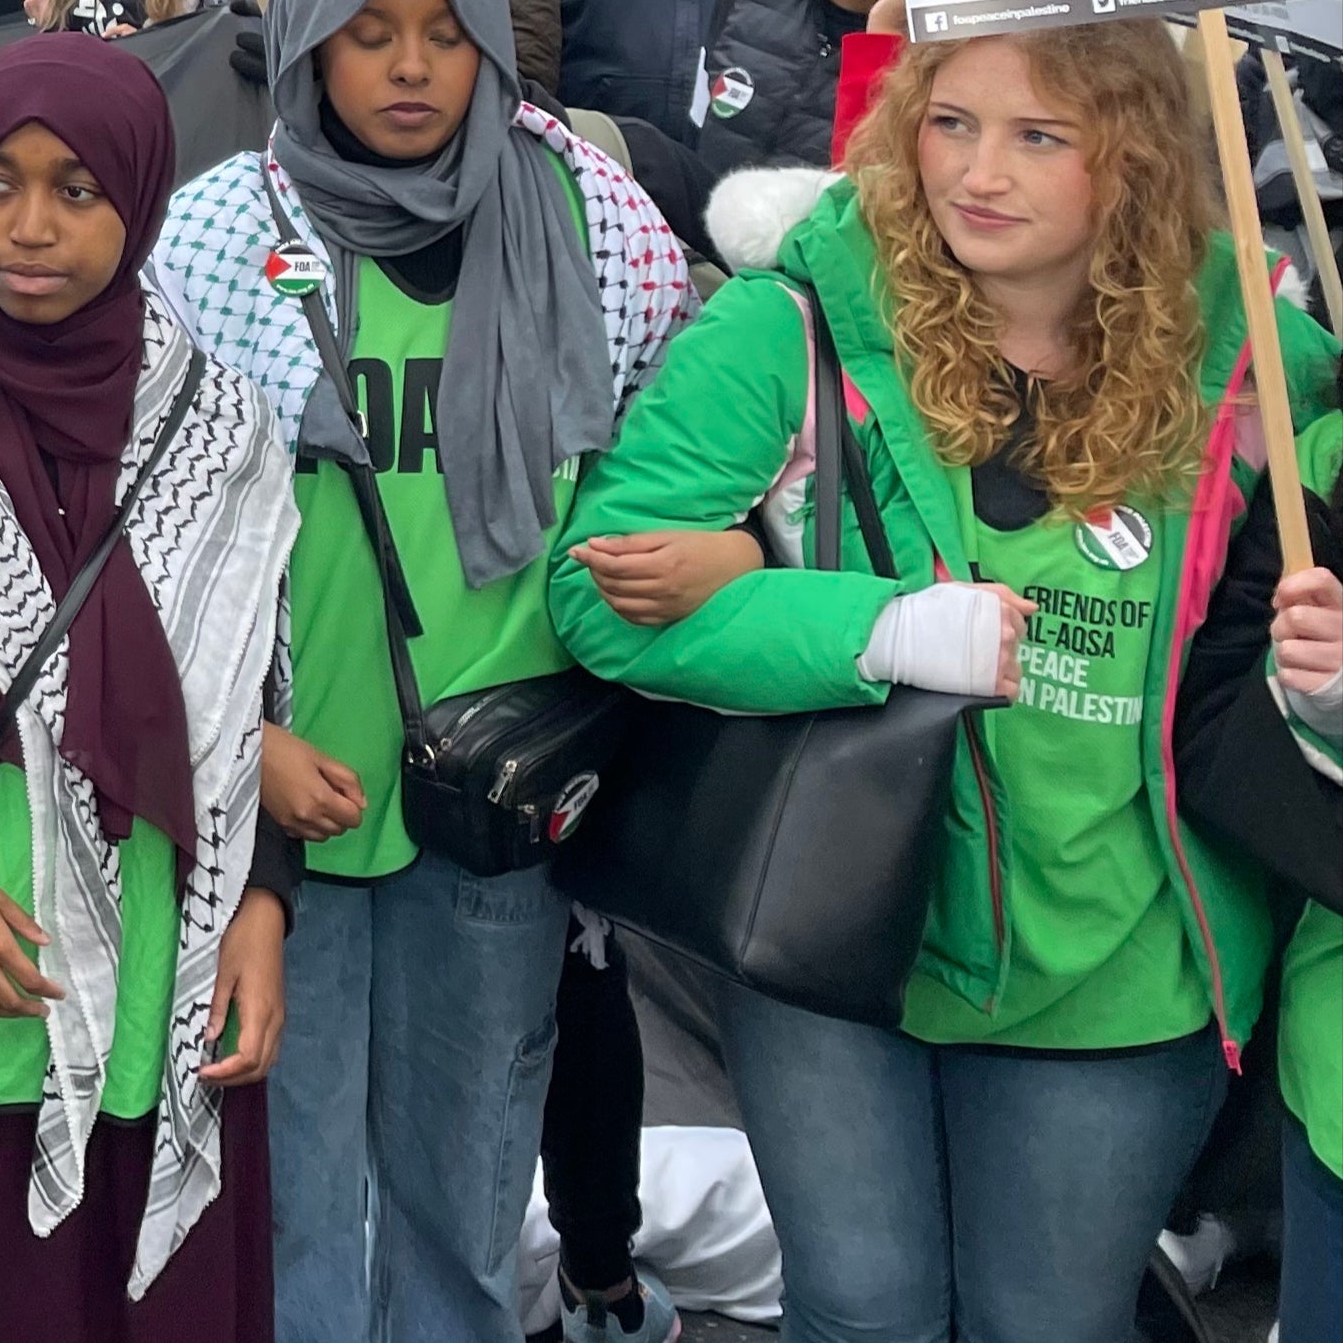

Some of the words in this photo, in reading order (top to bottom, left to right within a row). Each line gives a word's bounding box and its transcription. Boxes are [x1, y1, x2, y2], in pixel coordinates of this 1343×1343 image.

[1023, 585, 1118, 627] FRIENDS
[1120, 600, 1152, 629] OF
[1023, 617, 1116, 658] AL-AQSA
[1016, 645, 1090, 688] PEACE
